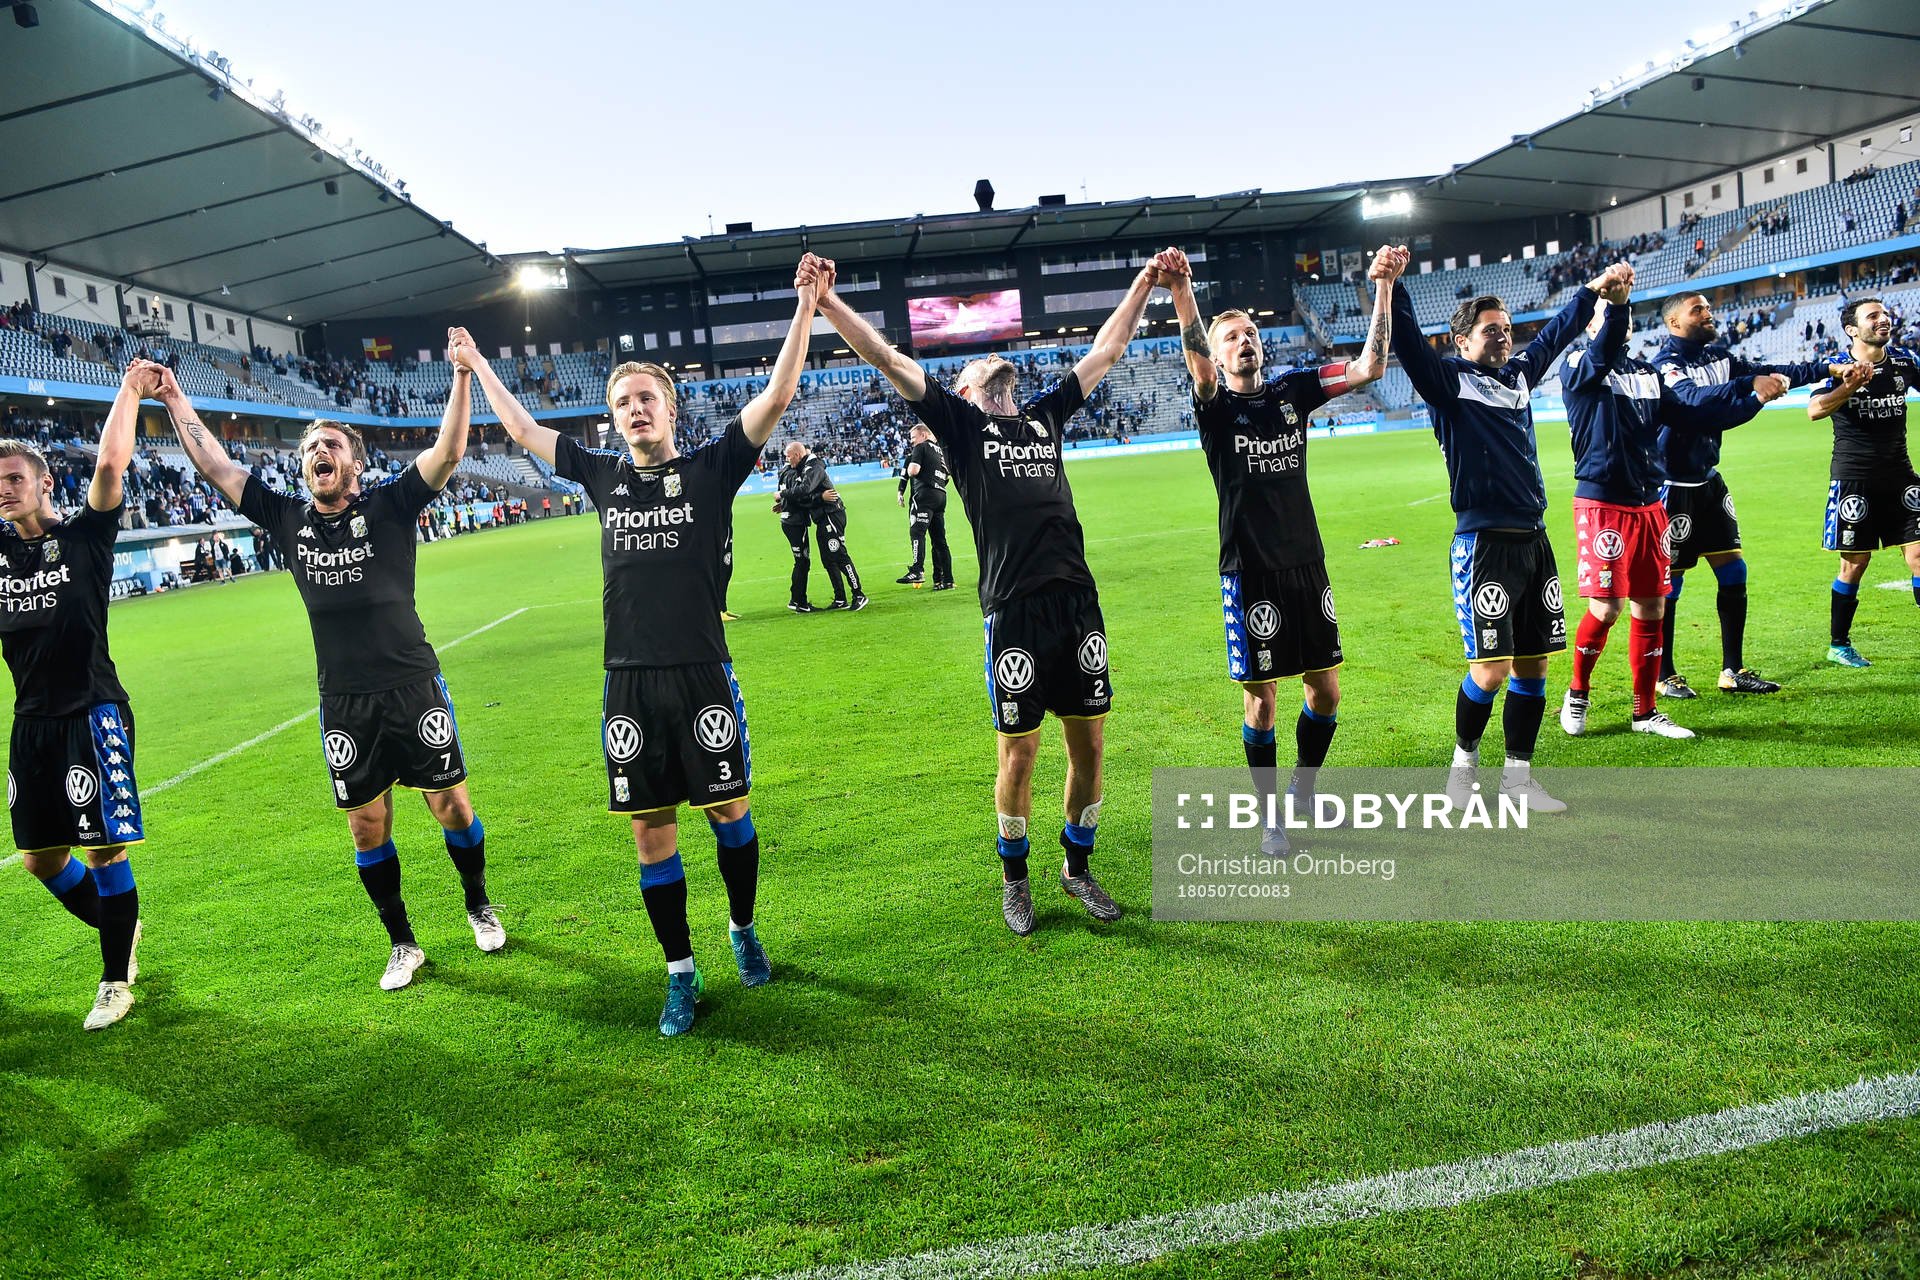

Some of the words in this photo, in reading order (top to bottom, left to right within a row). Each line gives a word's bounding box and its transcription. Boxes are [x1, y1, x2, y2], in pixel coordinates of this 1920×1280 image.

[816, 368, 886, 388] KLUBBE
[1848, 394, 1905, 408] Priorite
[984, 441, 1057, 460] Prioritet
[1234, 429, 1304, 455] Prioritet
[999, 459, 1056, 478] Finans
[1247, 454, 1300, 473] Finans
[605, 502, 694, 528] Prioritet
[613, 528, 679, 551] Finans
[297, 541, 374, 567] Prioritet
[0, 564, 70, 593] rioritet
[306, 563, 363, 586] Finans
[1551, 619, 1566, 636] 23
[1094, 679, 1105, 697] 2
[440, 752, 451, 771] 7
[718, 760, 732, 780] 3
[709, 779, 743, 793] Kappa
[78, 814, 91, 830] 4
